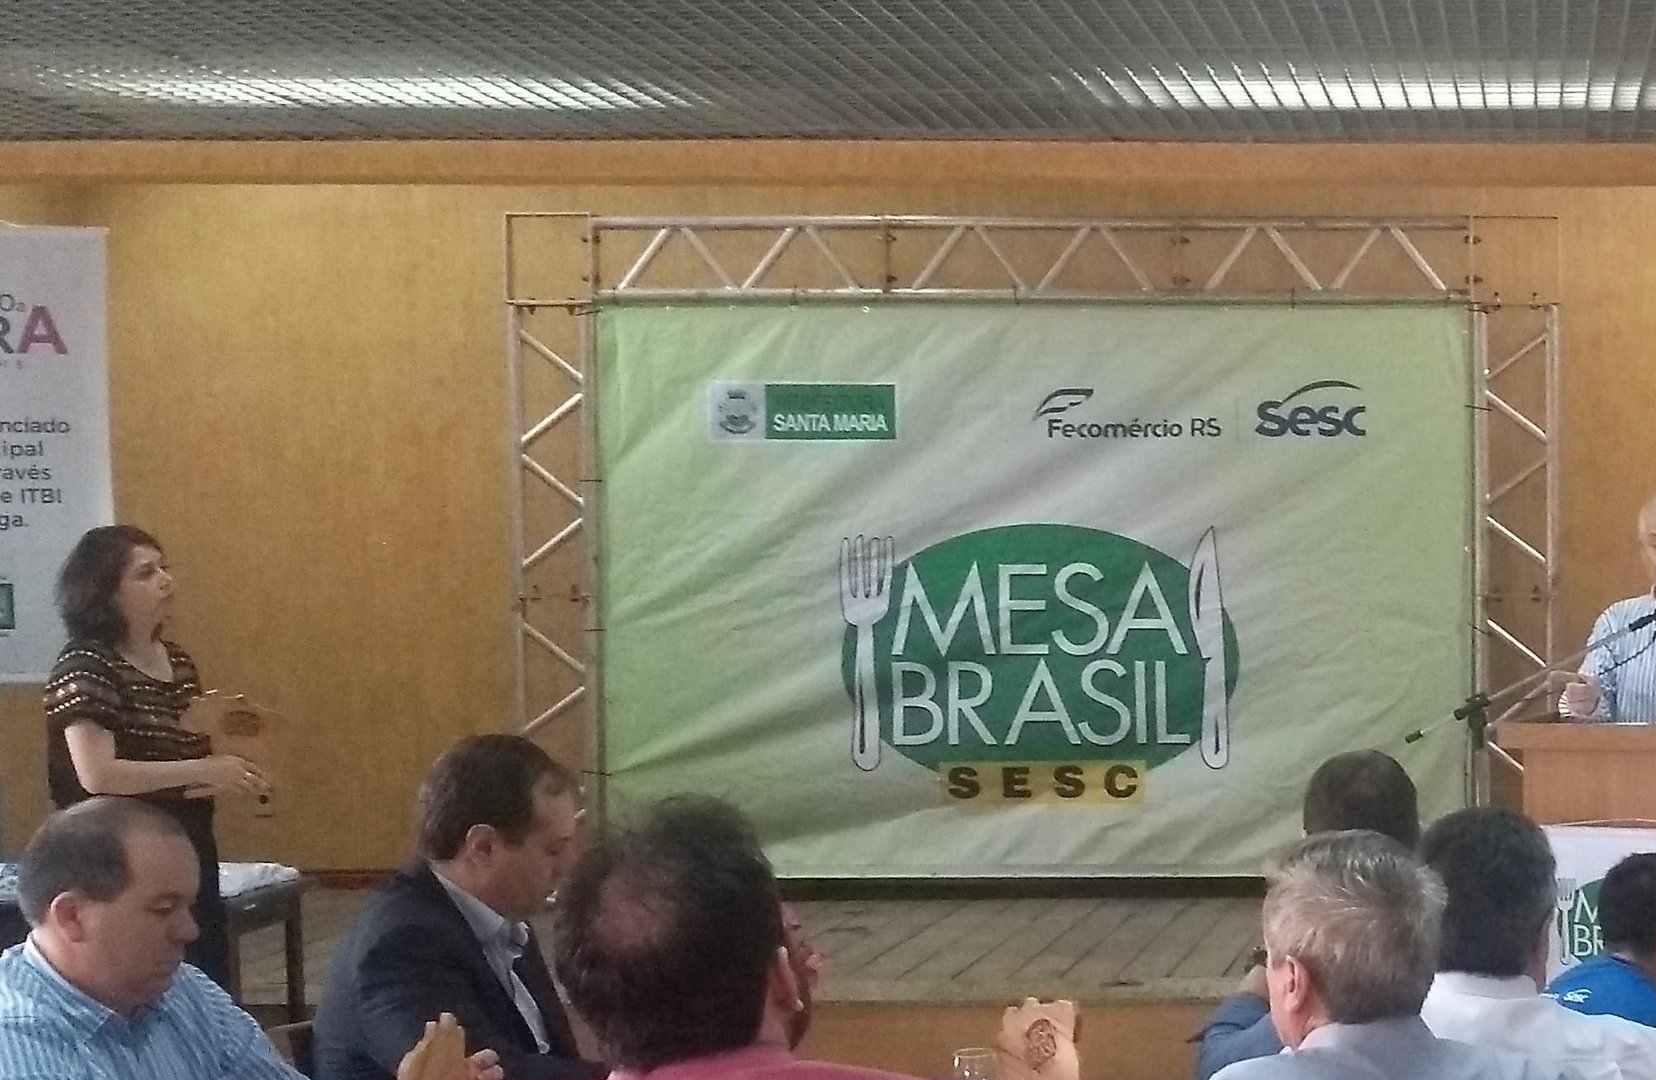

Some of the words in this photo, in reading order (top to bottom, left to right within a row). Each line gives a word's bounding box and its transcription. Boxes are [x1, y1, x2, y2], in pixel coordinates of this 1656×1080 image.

[773, 414, 831, 432] SANTA
[833, 414, 888, 432] MARIA
[1048, 418, 1183, 438] Fecomércio
[1191, 418, 1222, 437] RS
[1255, 398, 1367, 437] Sesc
[891, 561, 1189, 656] MESA
[891, 658, 1191, 746] BRASIL
[948, 765, 1138, 799] SESC
